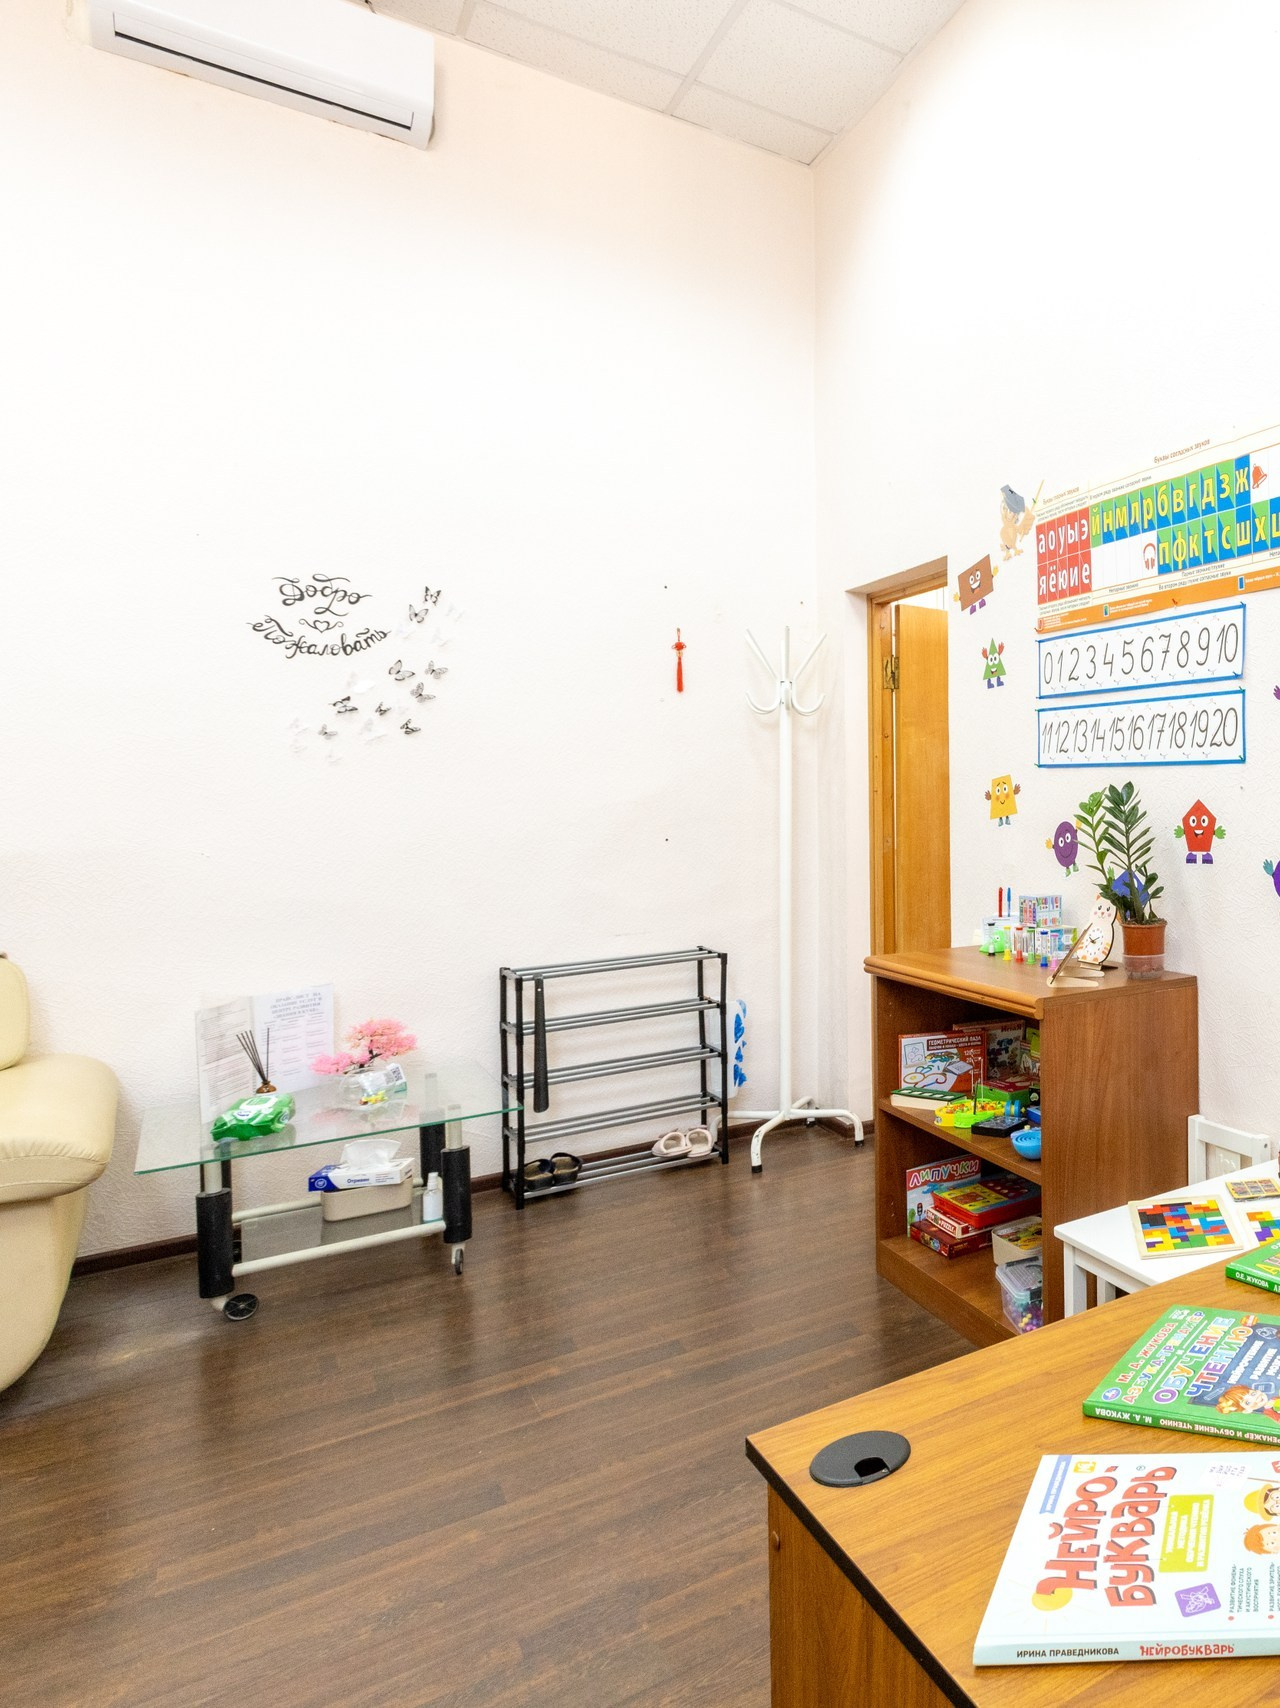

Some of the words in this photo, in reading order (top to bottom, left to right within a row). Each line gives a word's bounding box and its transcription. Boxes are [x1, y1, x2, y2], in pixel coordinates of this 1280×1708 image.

[1039, 533, 1045, 553] а
[1048, 530, 1055, 550] о
[1058, 525, 1065, 554] у
[1068, 522, 1078, 543] ы
[1081, 519, 1088, 540] э
[1092, 507, 1100, 536] й
[1104, 510, 1113, 532] н
[1116, 506, 1127, 529] м
[1130, 502, 1139, 525] л
[1143, 497, 1153, 529] р
[1157, 484, 1168, 517] б
[1173, 489, 1184, 513] в
[1189, 483, 1197, 508] г
[1202, 477, 1215, 510] д
[1220, 473, 1230, 499] з
[1235, 467, 1249, 494] ж
[1039, 575, 1046, 595] я
[1049, 565, 1056, 592] ё
[1058, 568, 1067, 590] ю
[1070, 566, 1078, 587] и
[1082, 563, 1090, 584] е
[272, 573, 373, 617] Добро
[1044, 652, 1053, 684] 0
[1058, 650, 1064, 683] 1
[1068, 647, 1080, 681] 2
[1086, 645, 1097, 679] 3
[1103, 643, 1114, 677] 4
[1121, 639, 1135, 675] 5
[1141, 636, 1154, 672] 6
[1159, 633, 1171, 671] 7
[1177, 630, 1190, 668] 8
[1196, 627, 1210, 666] 9
[1216, 622, 1238, 663] 10
[1042, 722, 1053, 754] 11
[1055, 720, 1070, 753] 12
[1073, 719, 1087, 752] 13
[1091, 718, 1106, 752] 14
[1109, 716, 1125, 751] 15
[1128, 715, 1144, 750] 16
[1148, 713, 1167, 750] 17
[1169, 711, 1187, 749] 18
[1190, 709, 1209, 748] 19
[1210, 707, 1238, 747] 20
[928, 1036, 969, 1046] ГЕОМЕТРИЧЕСКИЙ
[909, 1159, 980, 1188] ЛИПУЧКИ
[1235, 1272, 1245, 1281] О.Е.
[1245, 1274, 1269, 1288] ЖУКОВА
[1136, 1322, 1178, 1359] ЖУКОВА
[1122, 1311, 1205, 1404] АЗБУКА-ТРЕНАЖЁР
[1128, 1359, 1145, 1370] А.
[1152, 1317, 1236, 1404] ОБУЧЕНИЕ
[1184, 1326, 1254, 1397] ЧТЕНИЮ
[1116, 1371, 1135, 1384] М.
[1095, 1407, 1125, 1421] ЖУКОВА
[1130, 1414, 1141, 1422] А.
[1142, 1415, 1152, 1424] М.
[1159, 1418, 1193, 1430] ЧТЕНИЮ
[1194, 1424, 1236, 1436] ОБУЧЕНИЕ
[1032, 1464, 1119, 1596] НЕЙРО-
[1016, 1647, 1047, 1659] ИРИНА
[1049, 1646, 1120, 1658] ПРАВЕДНИКОВА
